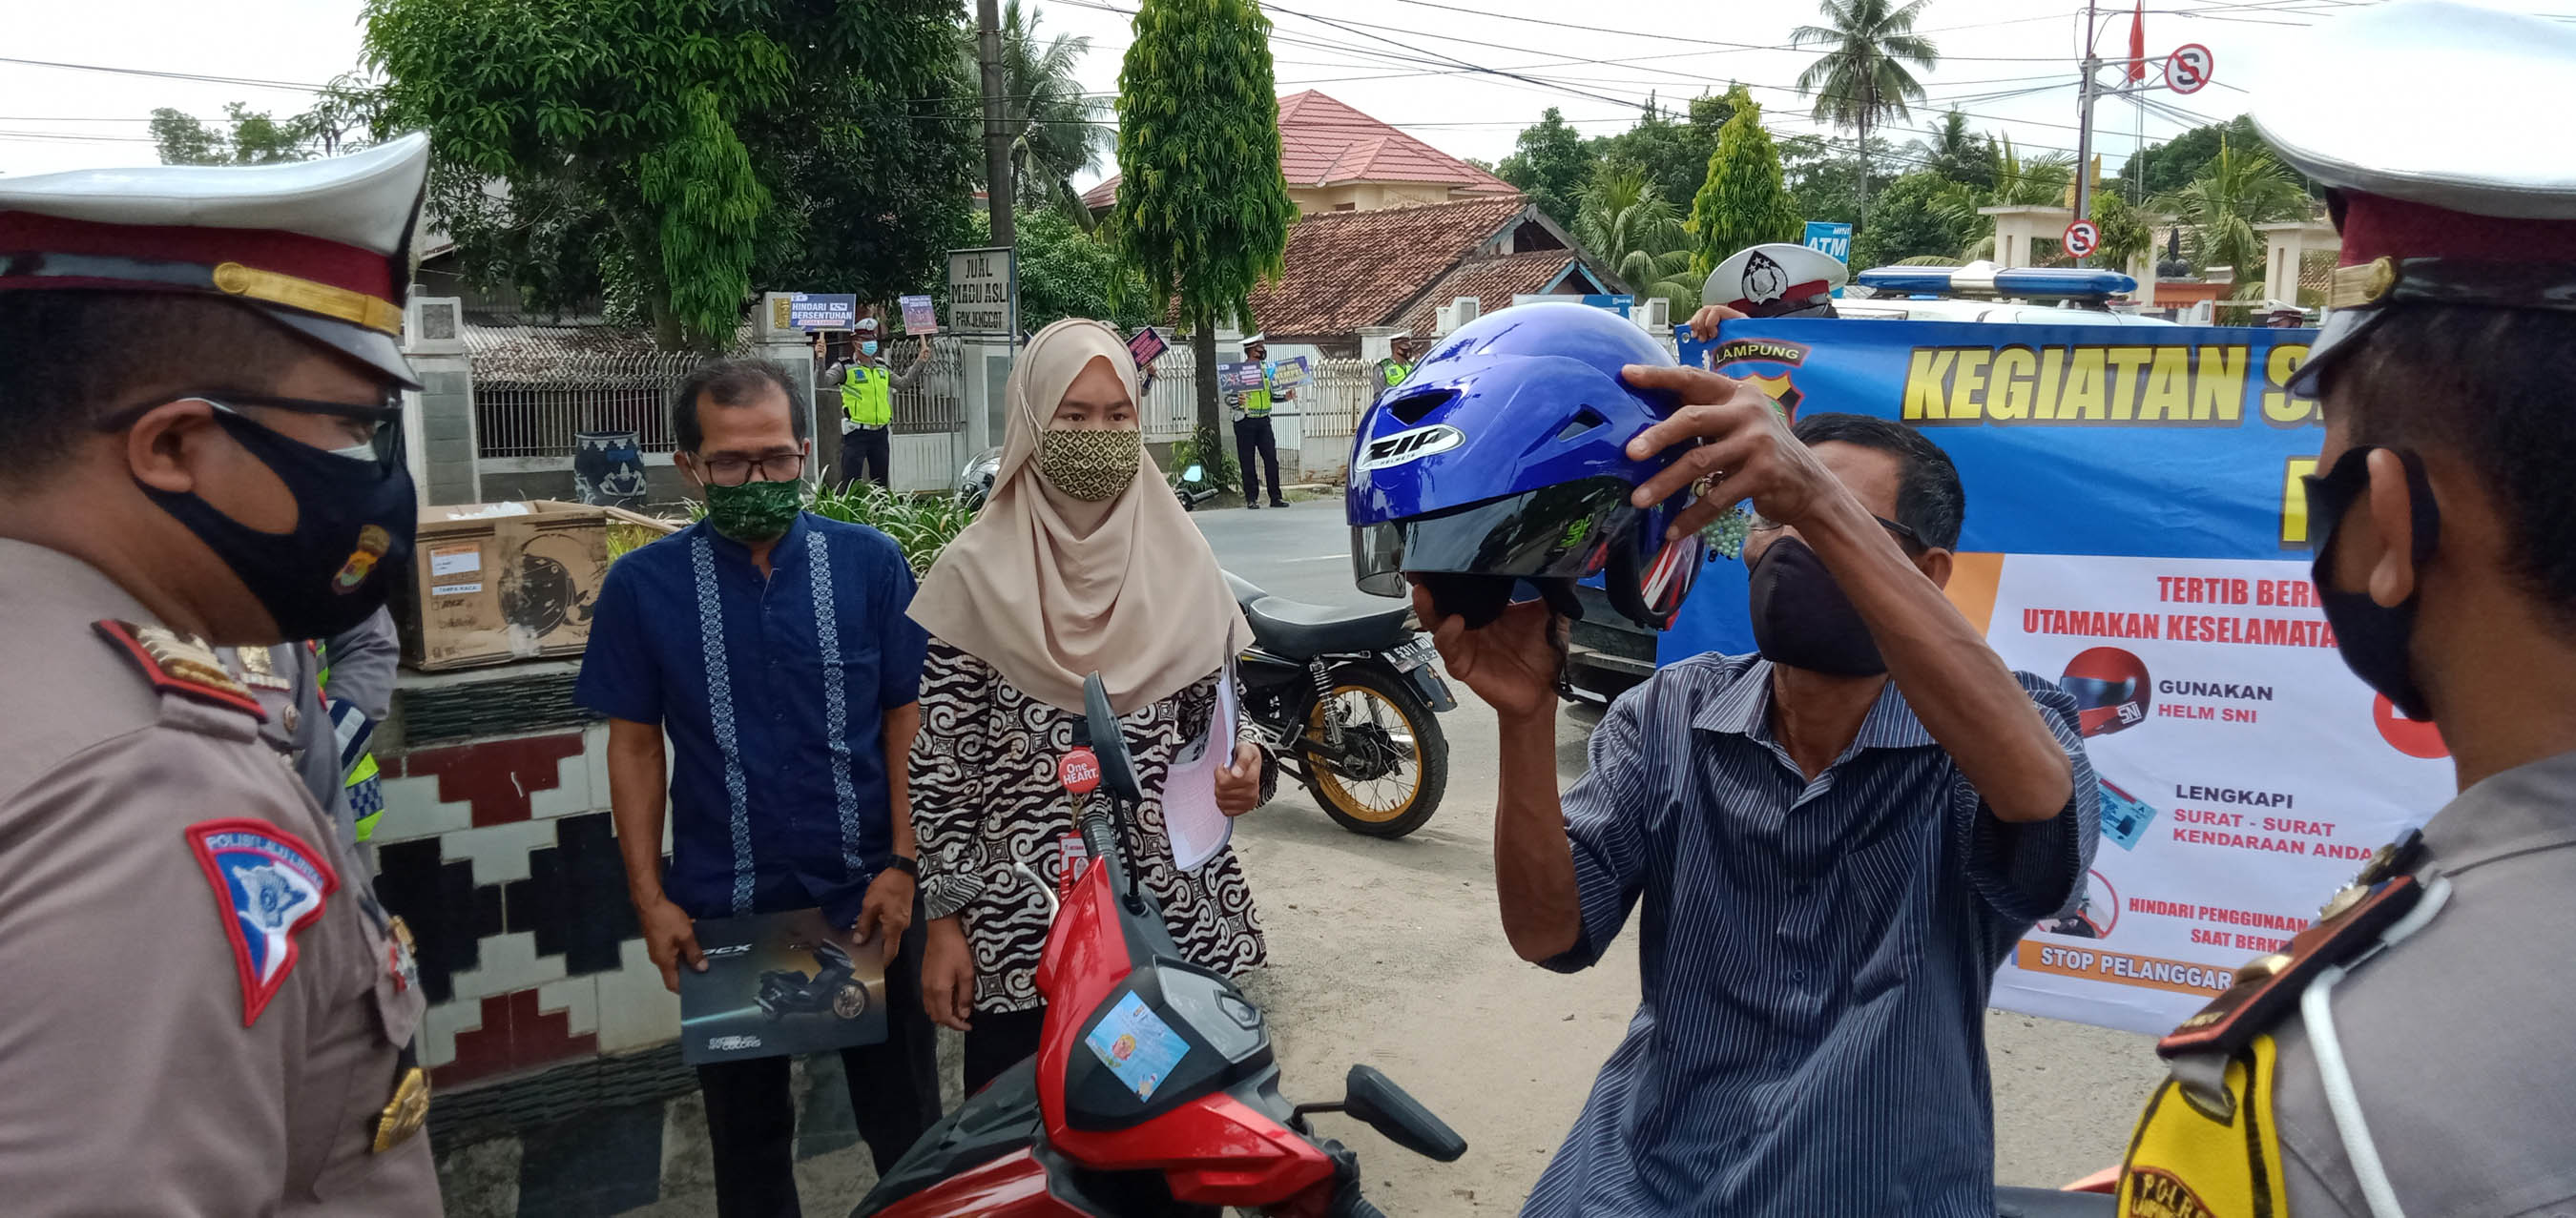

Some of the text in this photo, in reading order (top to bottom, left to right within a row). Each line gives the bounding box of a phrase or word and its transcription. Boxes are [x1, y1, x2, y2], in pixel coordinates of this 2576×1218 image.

[1809, 237, 1848, 257] ATM
[966, 258, 993, 279] JUAL
[951, 283, 983, 304] MADU
[984, 282, 1009, 303] ASLI
[791, 312, 853, 320] BERSENTUHAN
[792, 302, 826, 312] HINDARI
[1716, 344, 1800, 363] LAMPUNG
[1902, 344, 2324, 423] KEGIATAN S
[2157, 576, 2249, 605] TERTIB
[2023, 609, 2338, 649] UTAMAKAN KESELAMATA
[1383, 652, 1397, 664] B
[1393, 642, 1419, 659] 5317
[2158, 679, 2274, 701] GUNAKAN
[2117, 703, 2142, 722] SNI
[2158, 704, 2257, 723] HELM SNI
[1063, 768, 1099, 785] HEART.
[1067, 763, 1088, 774] One
[2175, 784, 2294, 809] LENGKAPI
[2173, 809, 2244, 828] SURAT
[2262, 817, 2336, 837] SURAT
[2172, 828, 2373, 861] KENDARAAN ANDA
[2129, 898, 2309, 934] HINDARI PENGGUNAAN
[2191, 928, 2233, 947] SAAT
[2040, 945, 2233, 991] STOP PELANGGAR
